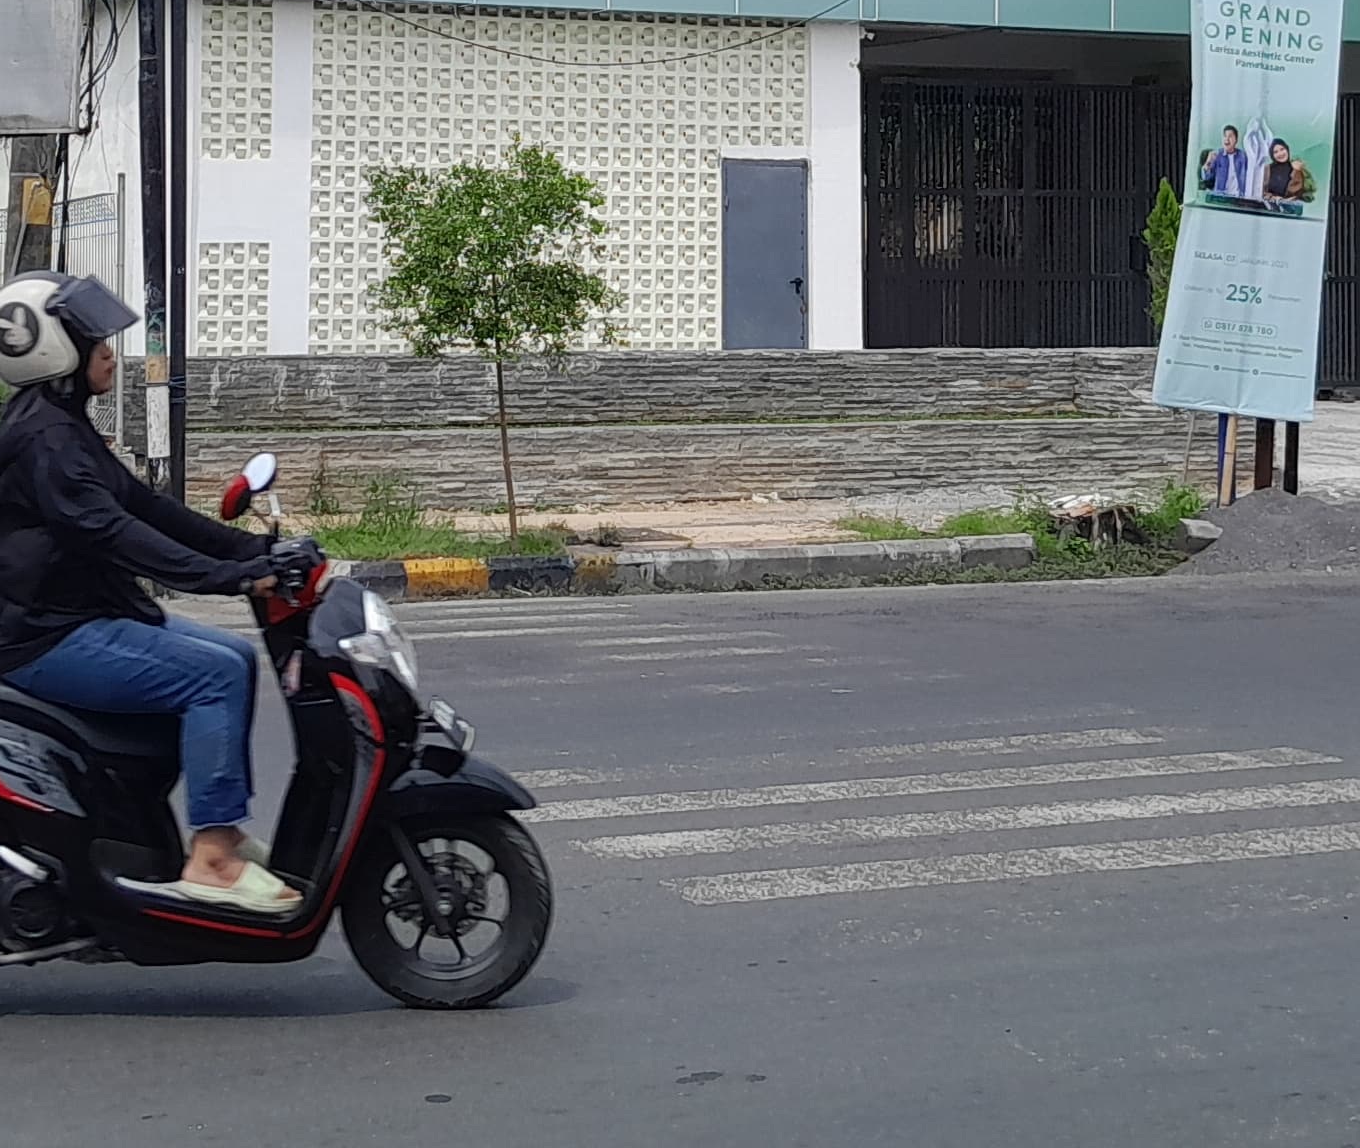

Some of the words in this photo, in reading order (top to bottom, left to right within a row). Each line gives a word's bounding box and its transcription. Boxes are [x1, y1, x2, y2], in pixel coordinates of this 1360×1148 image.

[1220, 0, 1311, 26] GRAND
[1204, 22, 1324, 52] OPENING
[1226, 283, 1263, 305] 25%
